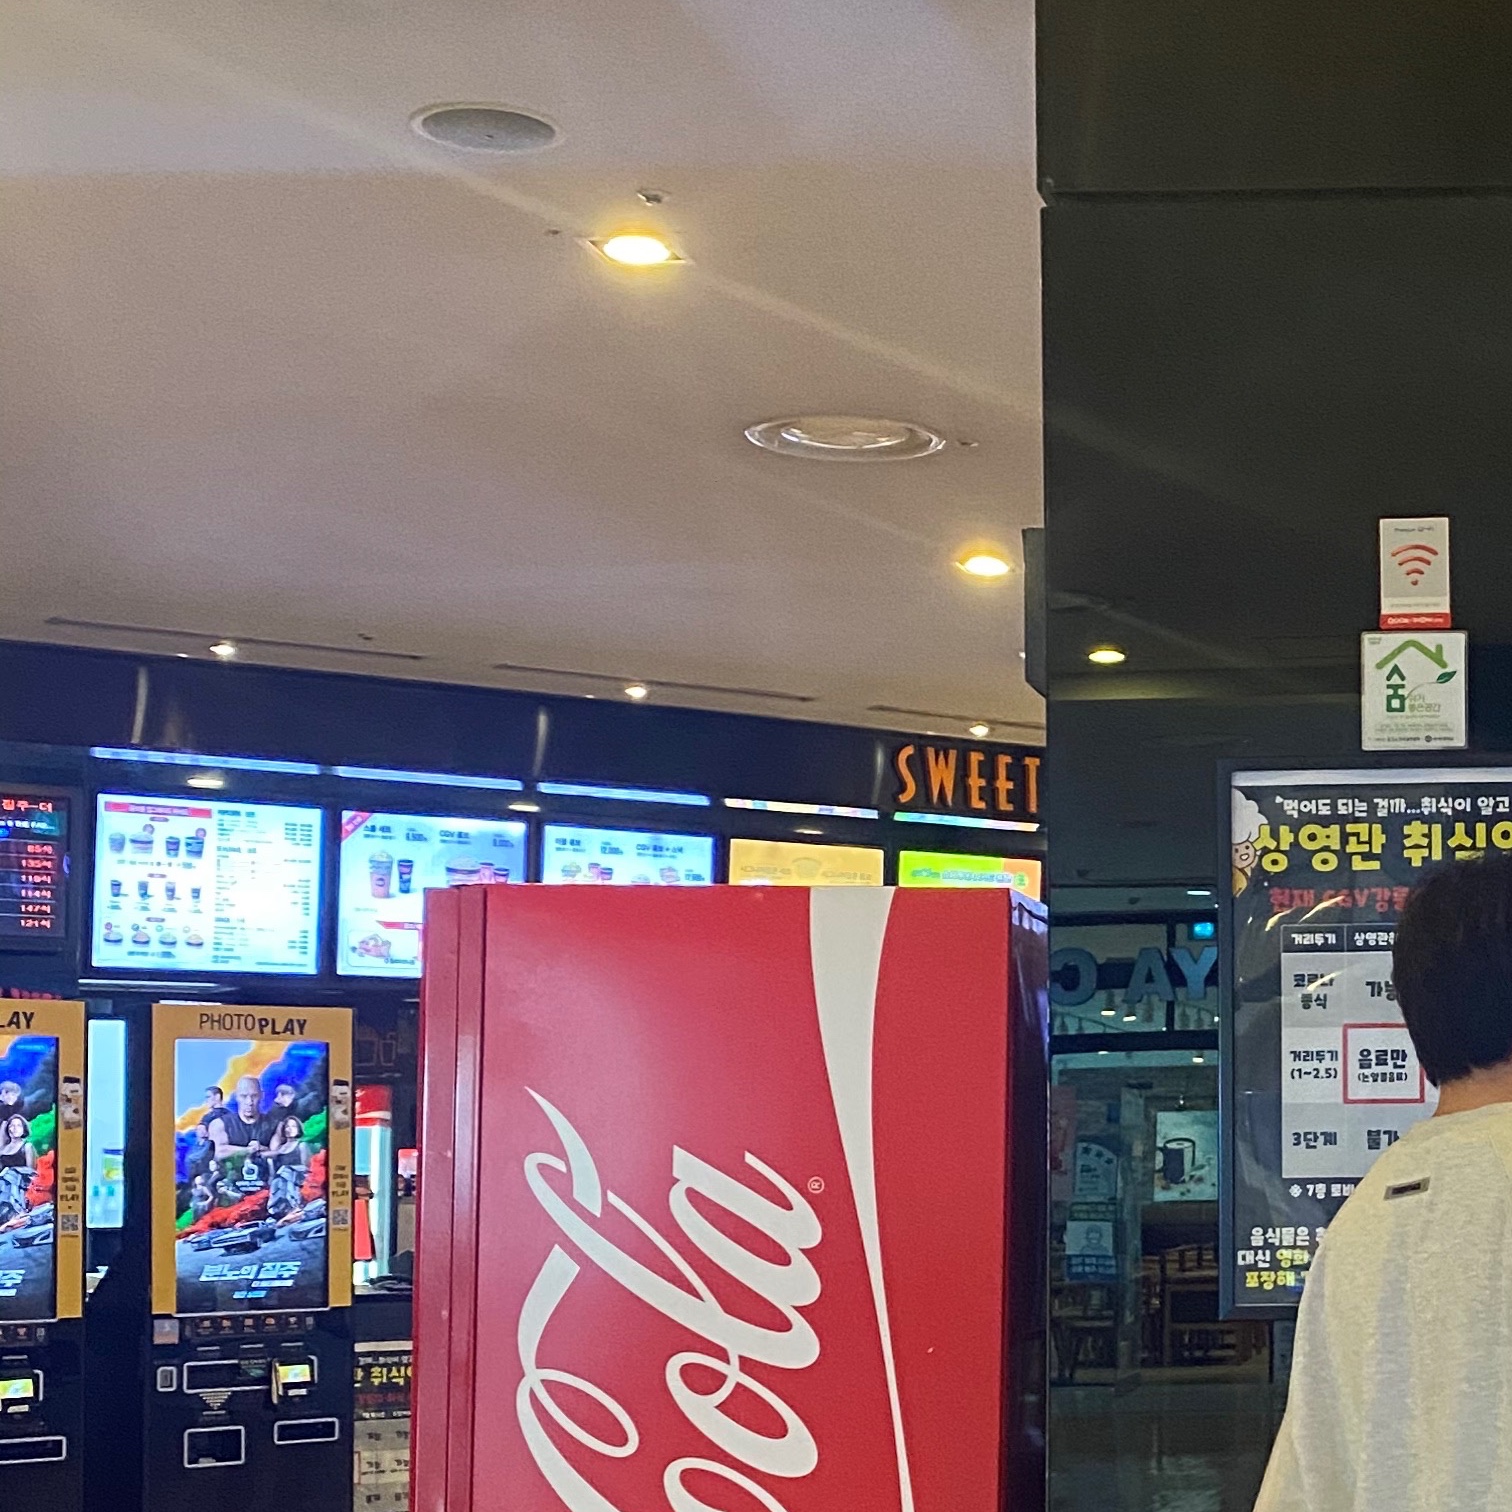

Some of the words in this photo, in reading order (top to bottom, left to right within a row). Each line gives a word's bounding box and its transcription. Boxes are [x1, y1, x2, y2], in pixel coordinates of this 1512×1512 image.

[895, 743, 1042, 814] SWEET
[1337, 798, 1368, 817] 되는
[1477, 796, 1510, 815] 알고
[1253, 821, 1387, 873] 상영관
[1291, 932, 1337, 946] 거리두기
[1290, 1050, 1338, 1063] 거리두기
[1358, 1048, 1408, 1069] 음료만
[1290, 1067, 1338, 1080] (1~2.5)
[1292, 1131, 1338, 1149] 3단계
[1306, 1183, 1326, 1199] 7층
[1250, 1226, 1311, 1247] 음식물은
[1237, 1249, 1270, 1268] 대신
[199, 1263, 259, 1282] 분노의
[257, 1261, 302, 1279] 질주
